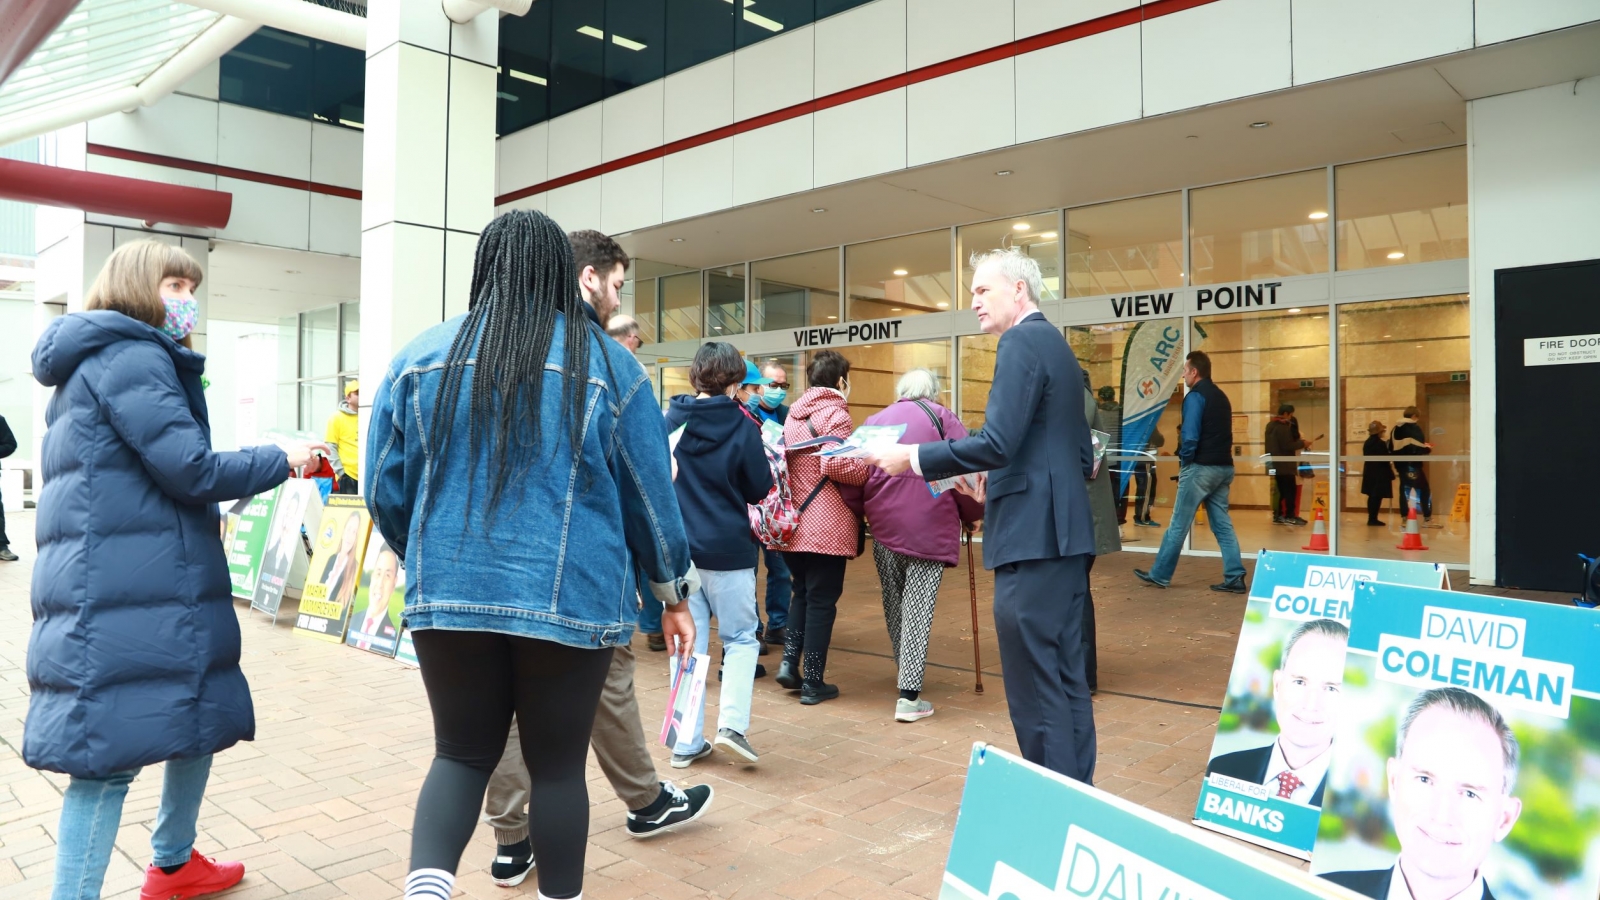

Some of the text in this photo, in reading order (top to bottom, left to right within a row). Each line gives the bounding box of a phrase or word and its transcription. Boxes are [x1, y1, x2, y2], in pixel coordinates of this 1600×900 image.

[1110, 281, 1282, 318] VIEW POINT
[793, 320, 902, 347] VIEW POINT
[1150, 326, 1180, 372] ARC
[1540, 340, 1564, 349] FIRE
[1274, 593, 1351, 620] COLEM
[1426, 613, 1519, 650] DAVID
[1381, 645, 1565, 706] COLEMAN
[1211, 775, 1267, 797] LIBERAL FOR
[1203, 792, 1285, 833] BANKS
